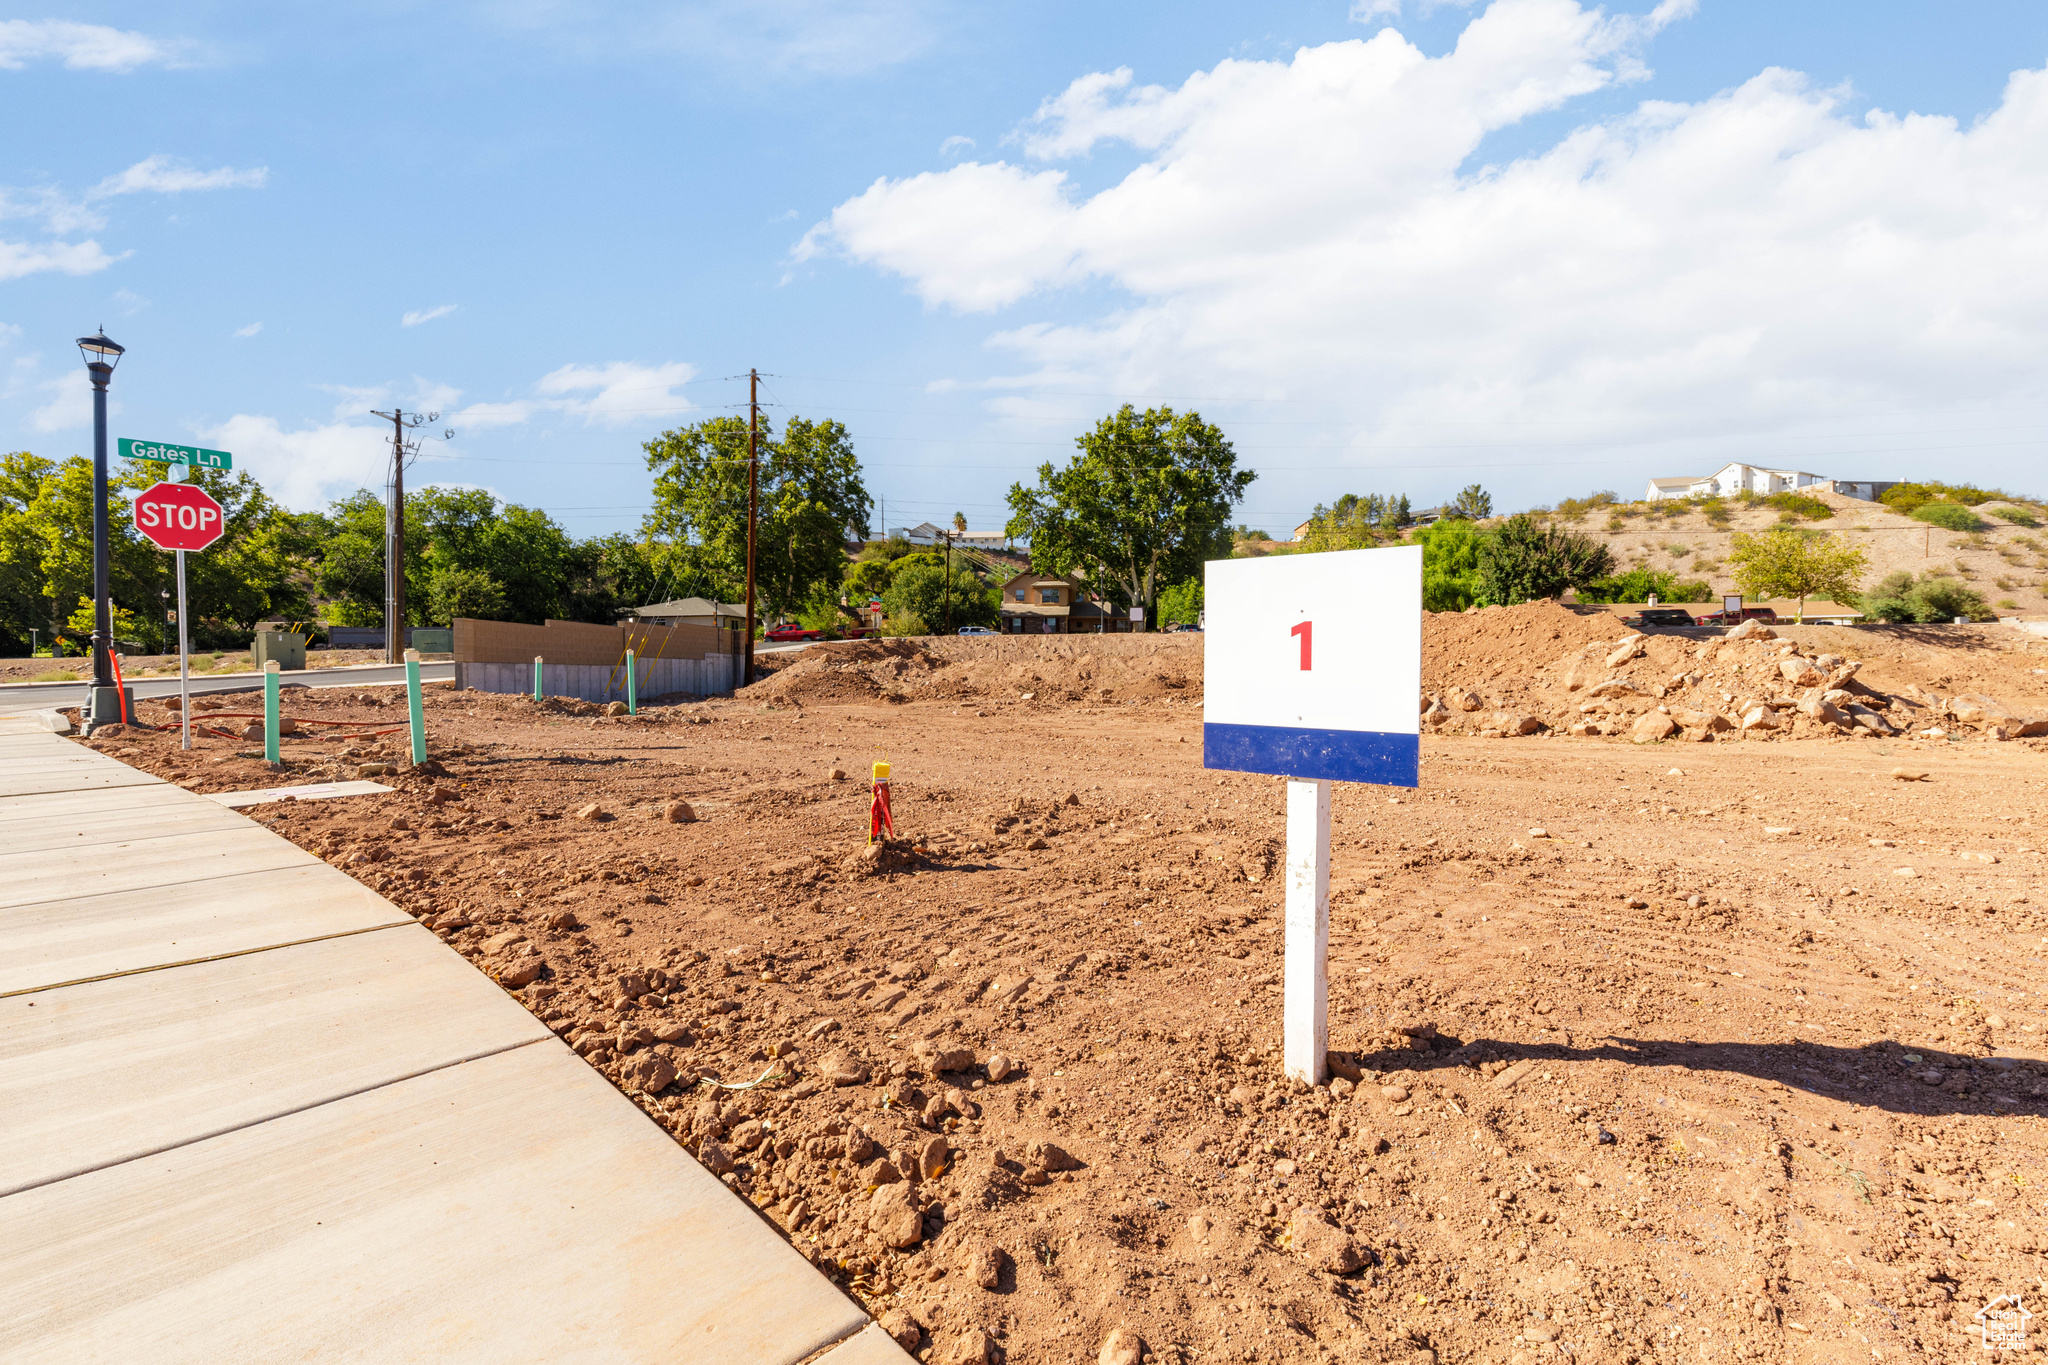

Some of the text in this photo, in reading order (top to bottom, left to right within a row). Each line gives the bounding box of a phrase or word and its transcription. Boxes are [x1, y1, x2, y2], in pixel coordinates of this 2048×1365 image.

[131, 441, 221, 467] Gates Ln
[141, 501, 217, 531] STOP
[1291, 621, 1312, 671] 1
